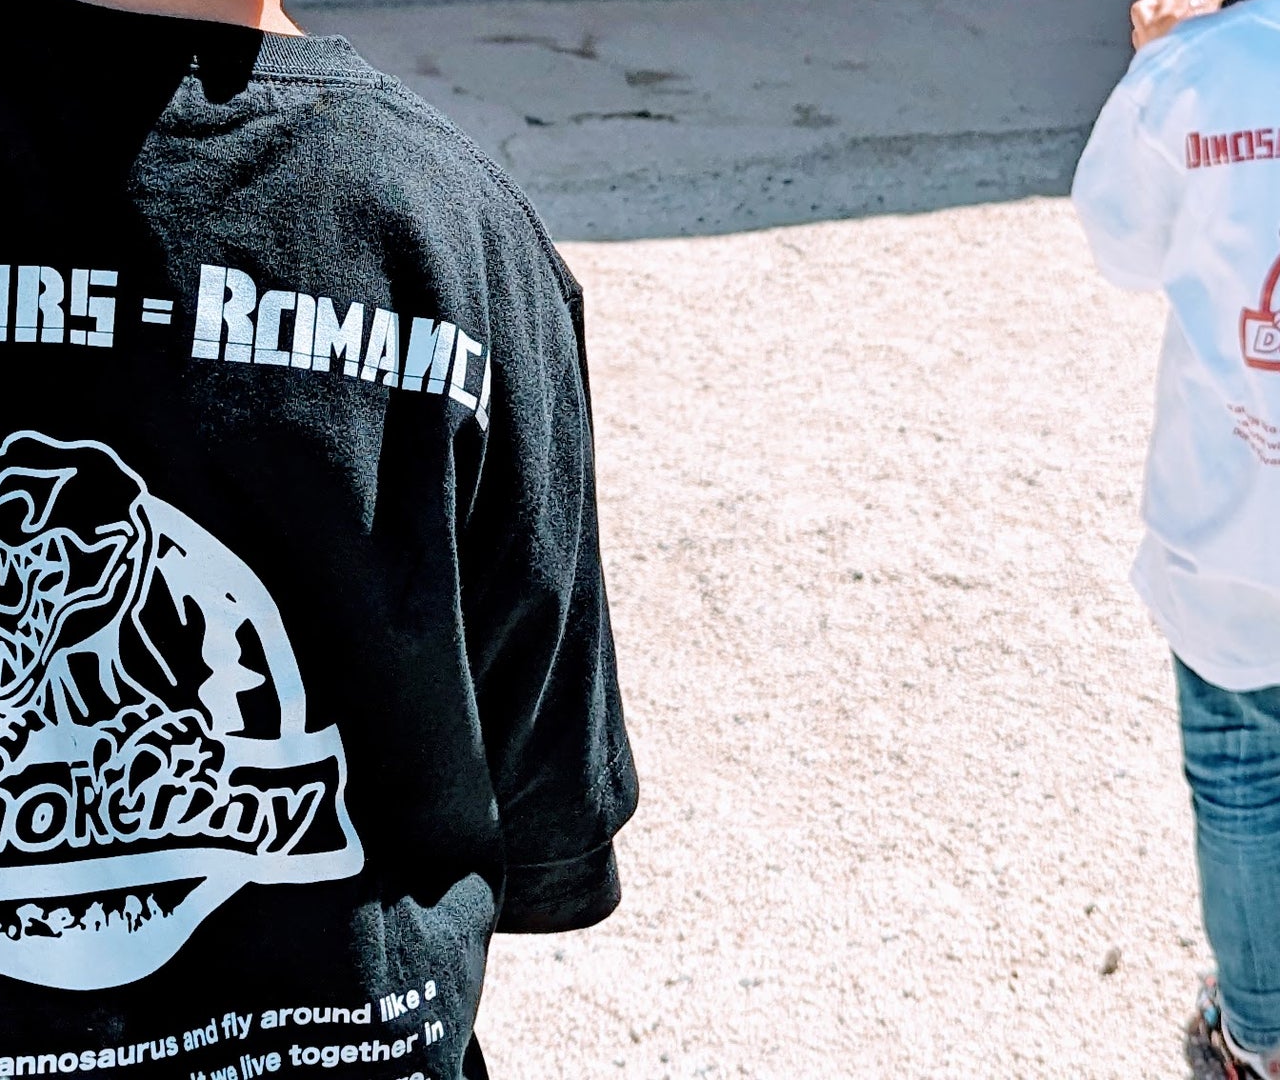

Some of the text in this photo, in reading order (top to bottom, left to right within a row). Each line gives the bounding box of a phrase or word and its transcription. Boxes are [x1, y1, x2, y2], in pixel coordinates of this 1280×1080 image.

[183, 1018, 219, 1052] and
[221, 1012, 254, 1040] fly
[260, 1003, 372, 1029] around
[378, 989, 420, 1023] like
[424, 980, 437, 1001] a
[239, 1054, 282, 1080] live
[288, 1033, 419, 1069] together
[424, 1020, 445, 1047] in
